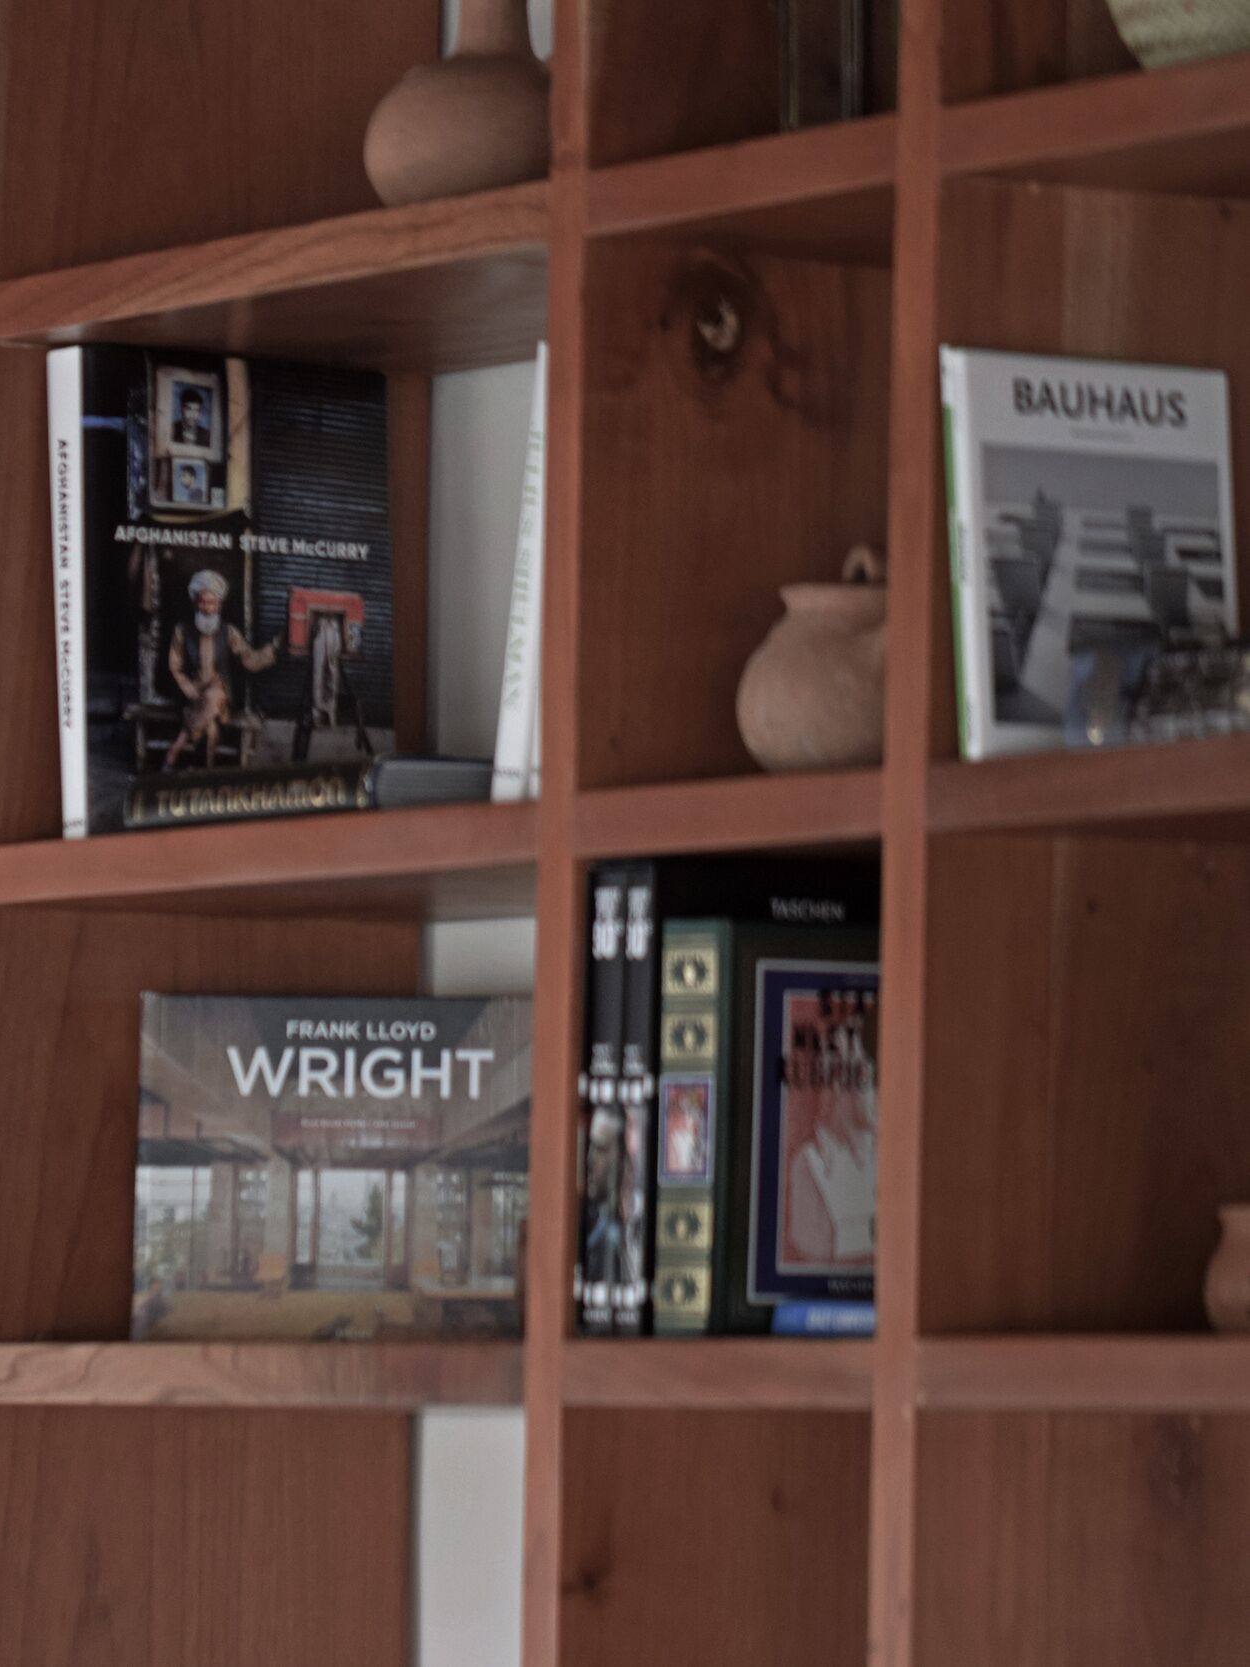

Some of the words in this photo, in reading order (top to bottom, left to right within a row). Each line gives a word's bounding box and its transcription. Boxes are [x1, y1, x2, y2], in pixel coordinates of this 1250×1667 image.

[1012, 376, 1188, 428] BAUHAUS
[57, 438, 69, 569] AFGHANISTAN
[114, 524, 232, 550] AFGHANISTAN
[239, 528, 289, 555] STEVE
[292, 537, 369, 561] McCURRY
[59, 579, 72, 634] STEVE
[285, 1019, 360, 1040] FRANK
[366, 1020, 437, 1042] LLOYD
[226, 1045, 495, 1100] WRIGHT
